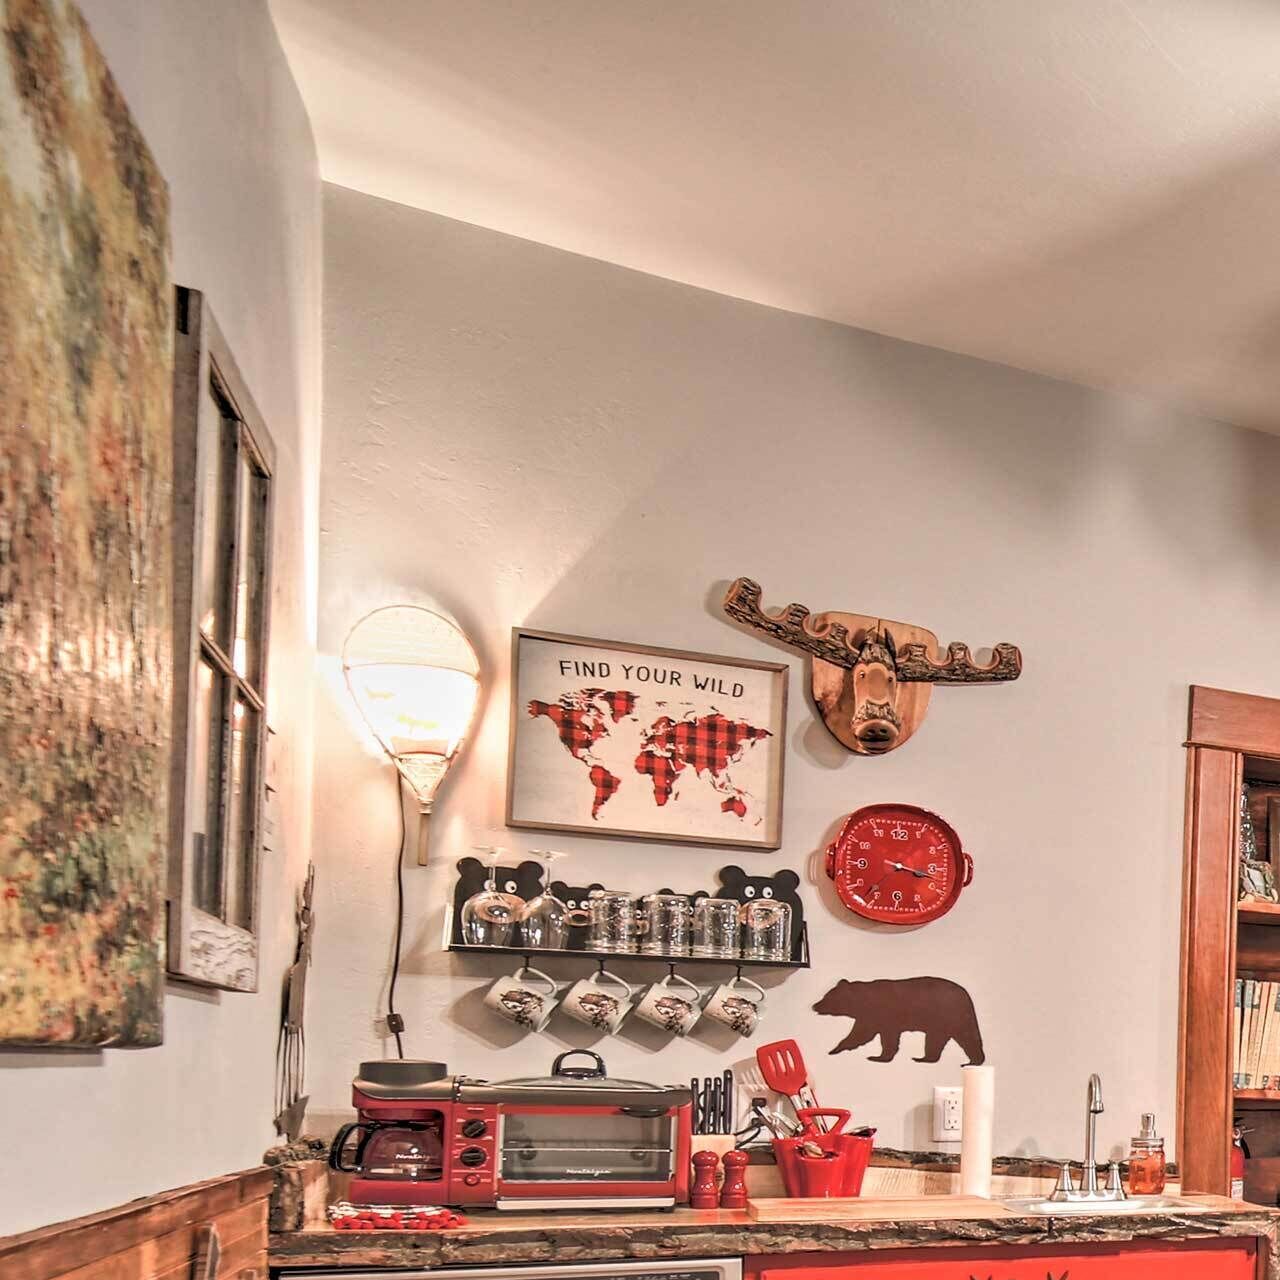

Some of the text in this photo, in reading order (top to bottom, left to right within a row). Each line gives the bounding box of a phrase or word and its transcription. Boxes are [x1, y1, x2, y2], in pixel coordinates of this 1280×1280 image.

[559, 660, 744, 698] FIND YOUR WILD
[891, 829, 908, 840] 12
[858, 858, 868, 870] 9
[928, 863, 936, 874] 3
[892, 890, 902, 902] 6
